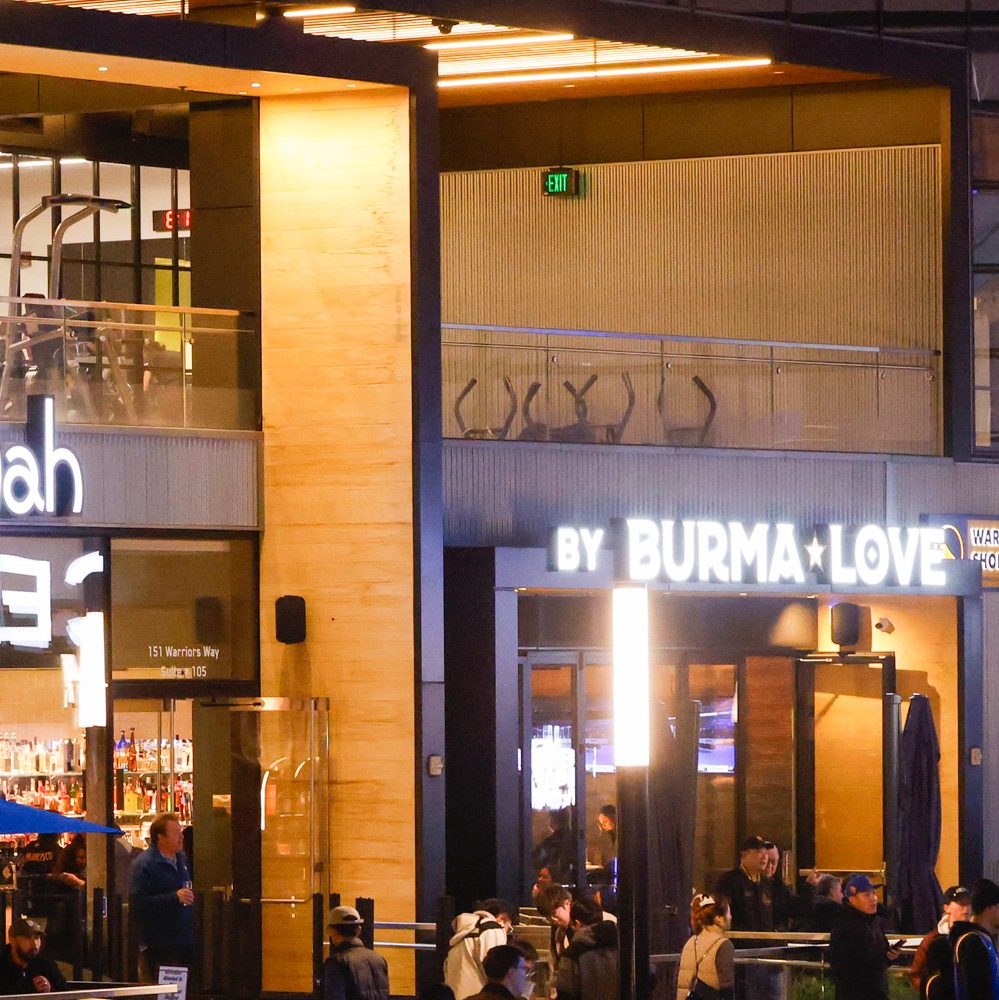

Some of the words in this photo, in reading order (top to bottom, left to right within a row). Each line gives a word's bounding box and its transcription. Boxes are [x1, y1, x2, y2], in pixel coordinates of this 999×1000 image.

[547, 173, 568, 193] EXIT
[556, 527, 604, 571] BY
[626, 519, 806, 584] BURMA
[829, 524, 947, 587] LOVE
[148, 645, 163, 658] 151
[164, 645, 202, 658] Warriors
[202, 645, 220, 660] Way
